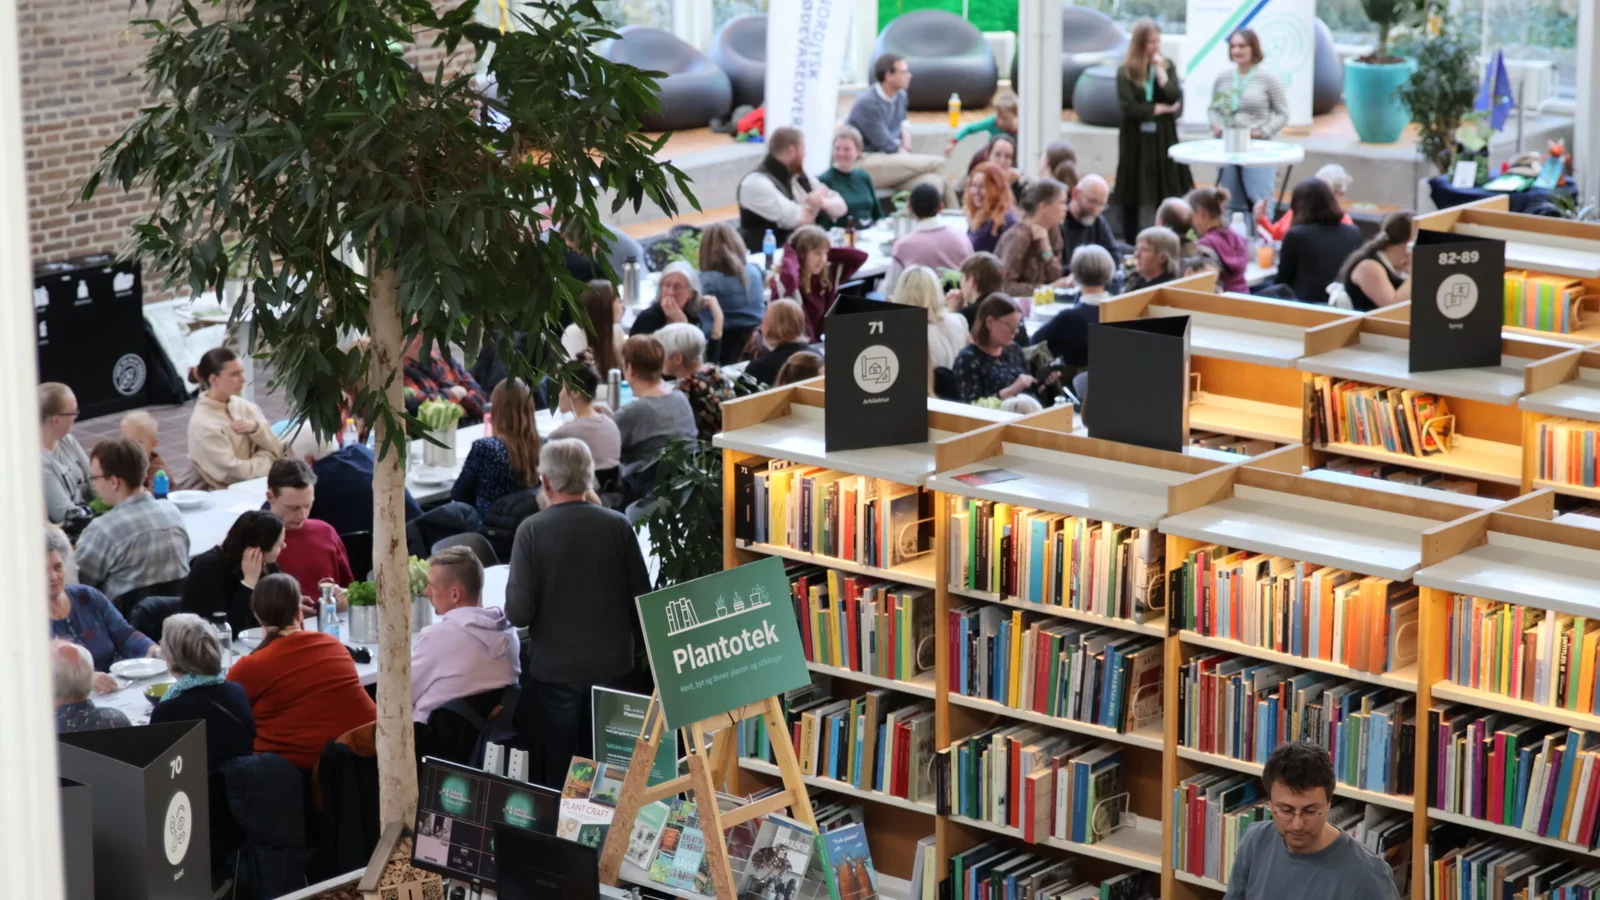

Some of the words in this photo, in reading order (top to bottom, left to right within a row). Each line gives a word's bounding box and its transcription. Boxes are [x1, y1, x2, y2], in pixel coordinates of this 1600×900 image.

[1438, 250, 1480, 265] 82-89
[868, 321, 884, 335] 71
[863, 397, 890, 405] Arkitektur
[740, 466, 748, 475] 71
[673, 620, 780, 674] Plantotek
[680, 683, 695, 693] Hent,
[695, 679, 705, 689] byt
[705, 677, 713, 686] og
[730, 664, 749, 678] planter
[750, 662, 758, 671] og
[623, 711, 645, 720] Plantotek
[170, 755, 183, 779] 70
[562, 801, 586, 813] PLANT
[586, 804, 609, 817] CRAFT
